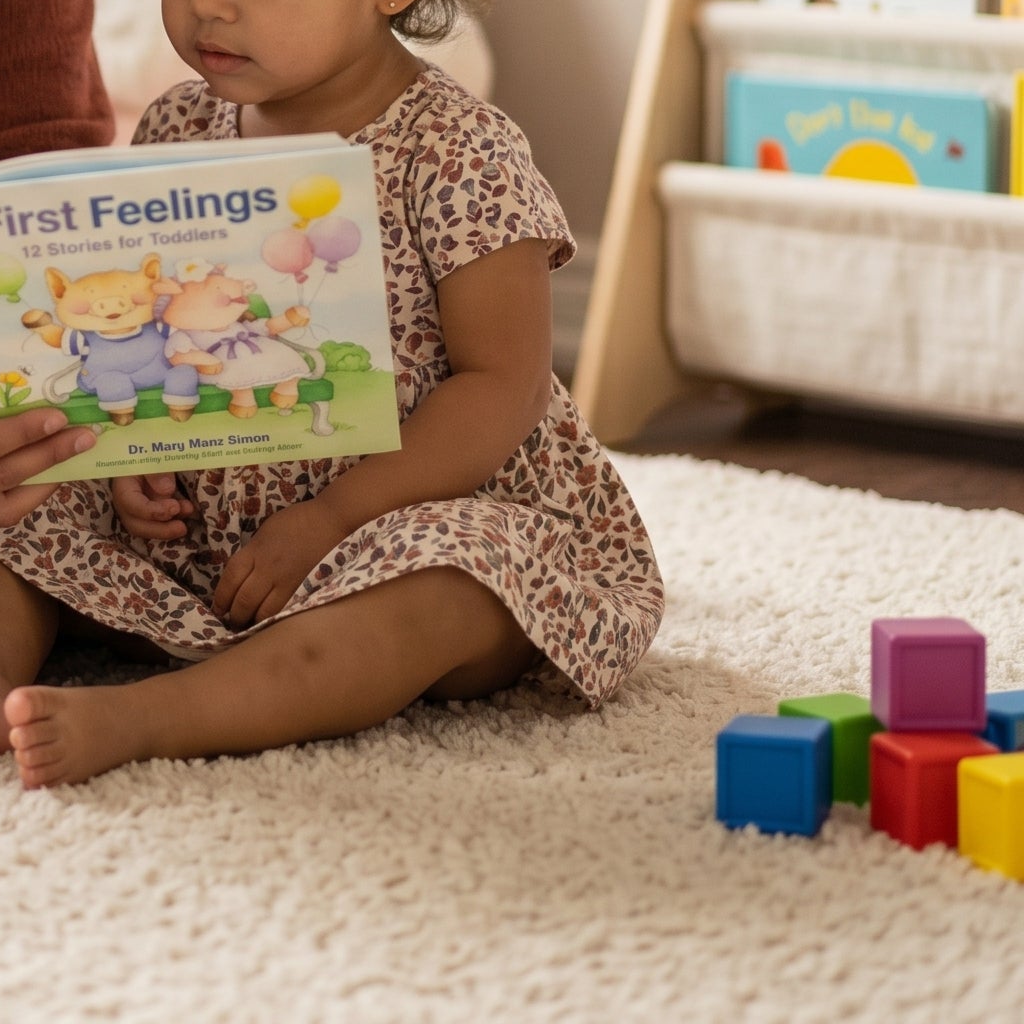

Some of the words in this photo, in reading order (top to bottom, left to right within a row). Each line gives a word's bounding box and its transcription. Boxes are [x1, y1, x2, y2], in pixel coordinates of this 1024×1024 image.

[89, 187, 278, 228] Feelings
[22, 244, 42, 259] 12
[47, 238, 113, 257] Stories
[118, 236, 143, 249] for
[149, 228, 229, 246] Toddlers
[128, 444, 148, 455] Dr.
[151, 441, 185, 453] Mary
[189, 437, 224, 449] Manz
[228, 433, 270, 445] Simon
